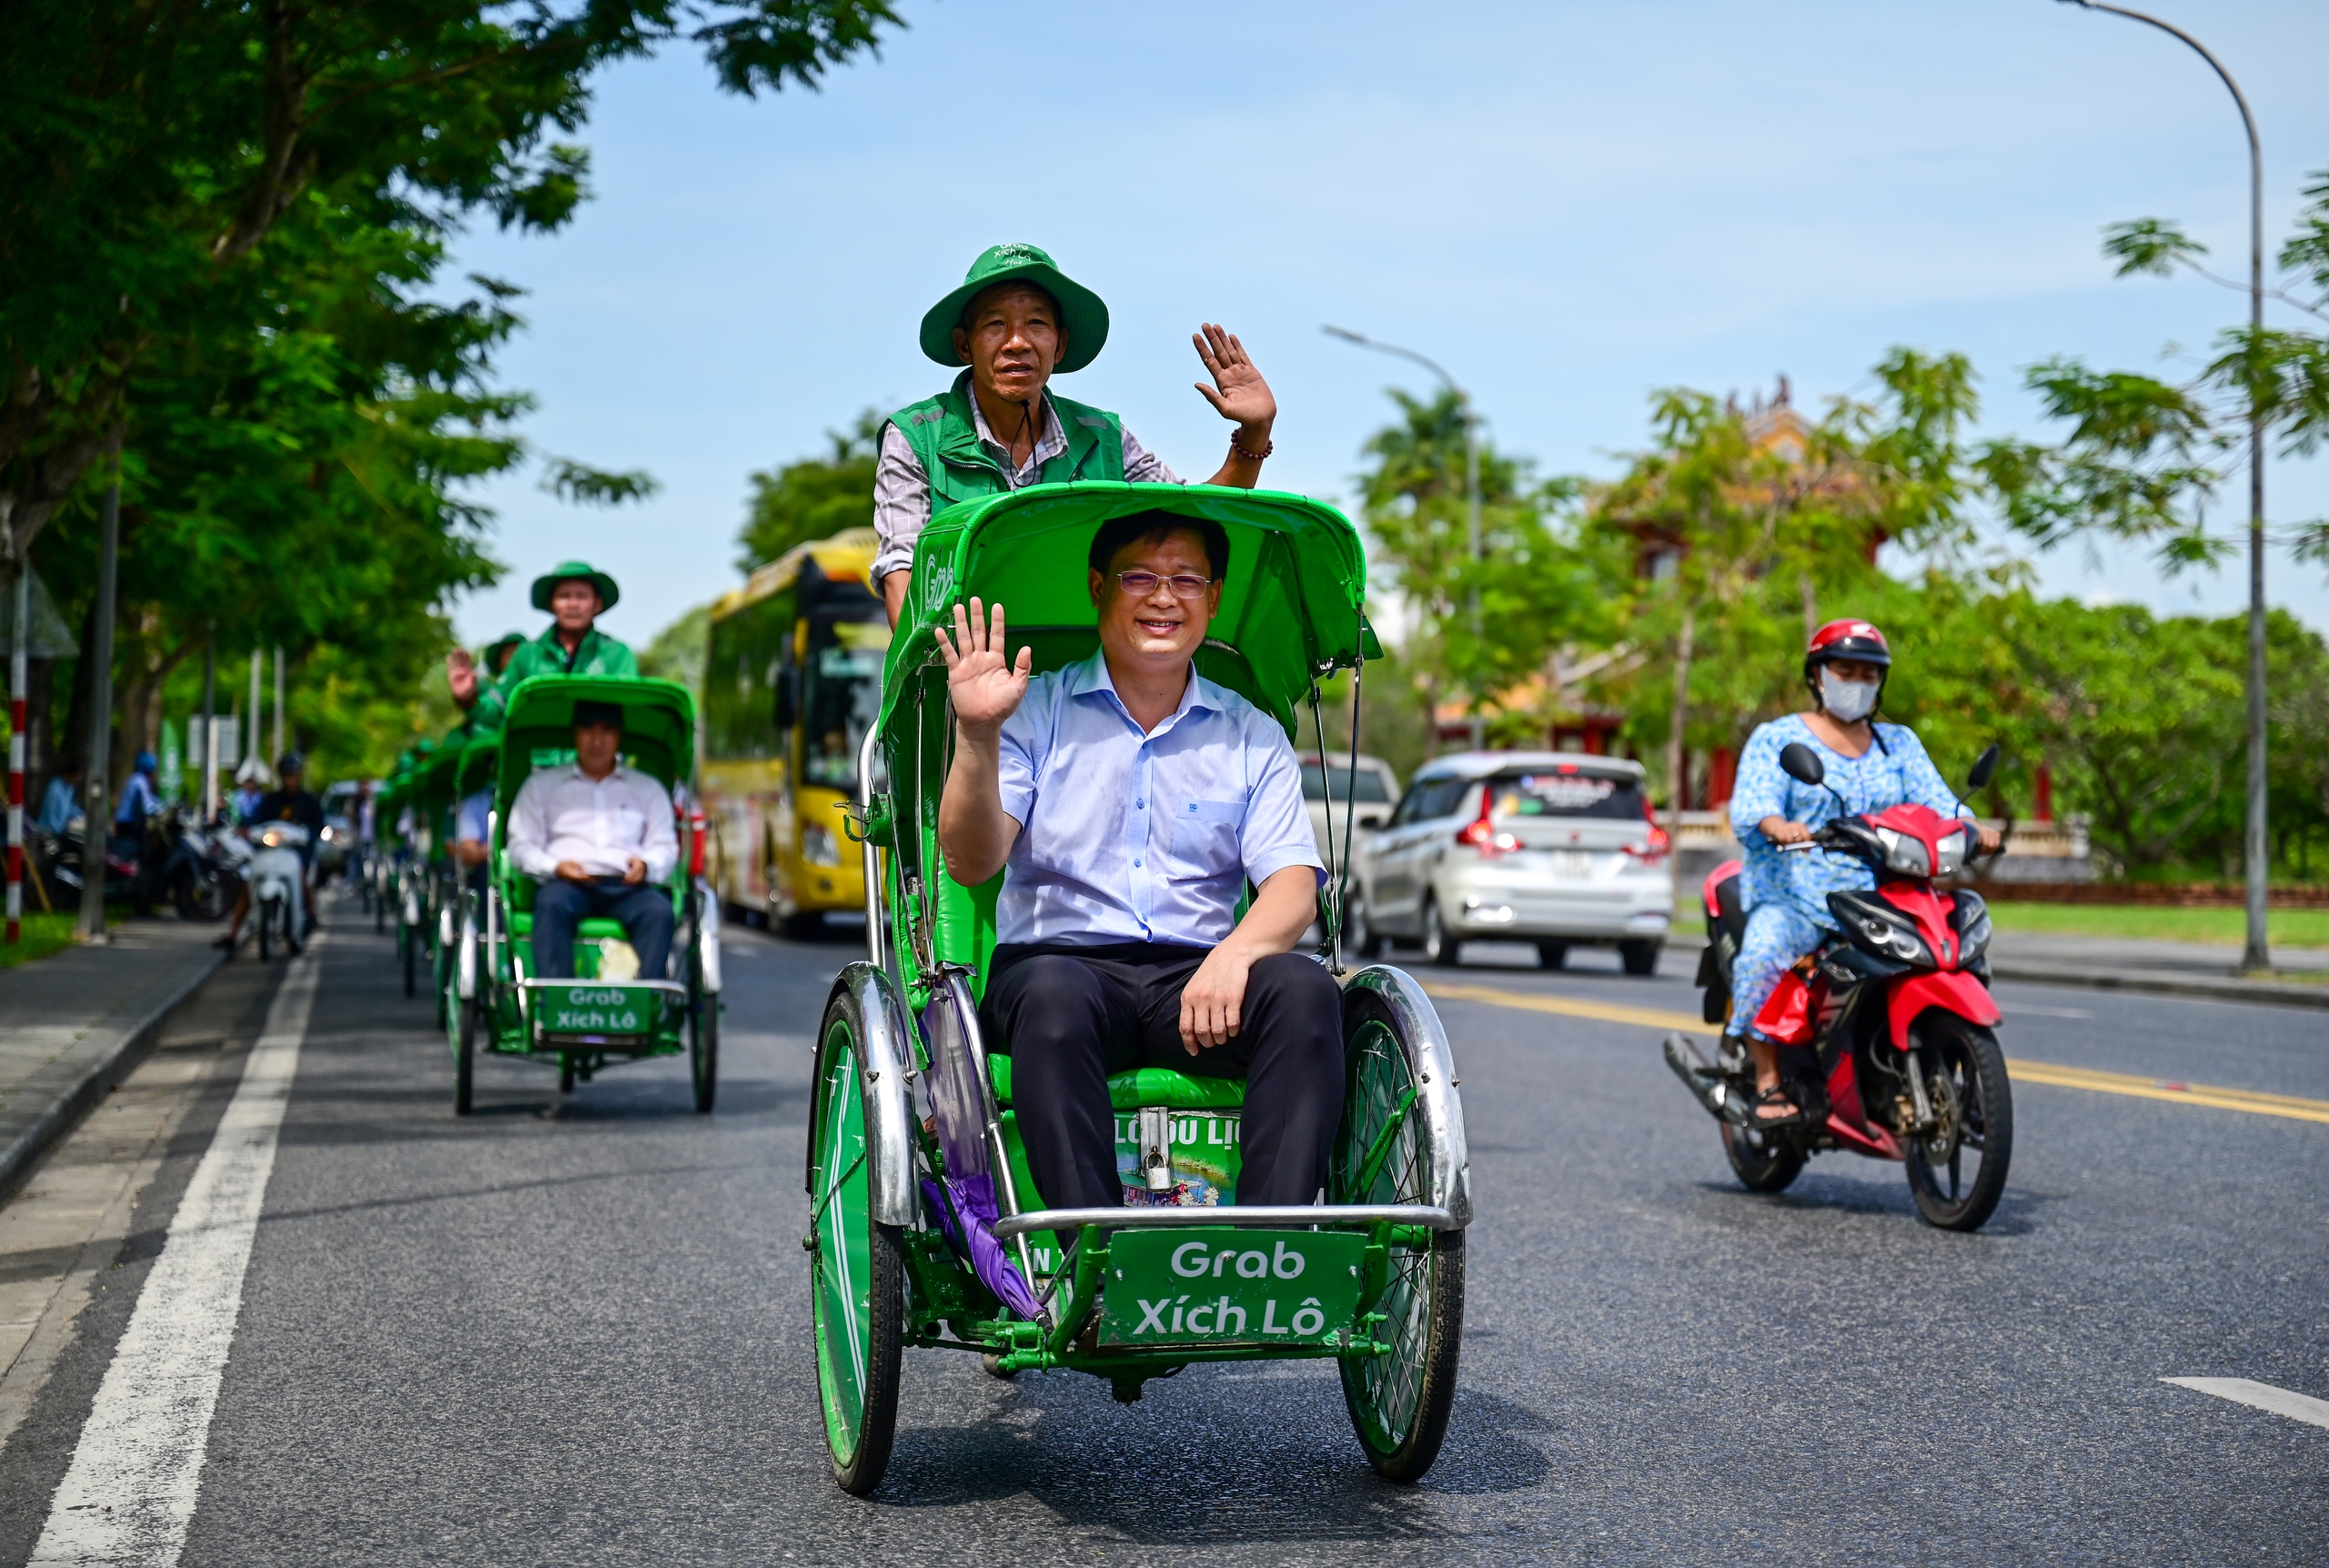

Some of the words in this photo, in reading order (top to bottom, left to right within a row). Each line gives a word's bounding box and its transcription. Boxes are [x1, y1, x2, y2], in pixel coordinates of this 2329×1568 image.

[569, 987, 626, 1006] Grab
[557, 1009, 605, 1028] Xích
[610, 1010, 637, 1029] Lô
[1207, 1120, 1241, 1151] LỊ
[1171, 1241, 1306, 1280] Grab
[1132, 1295, 1247, 1335] Xích
[1262, 1297, 1325, 1336] Lô
